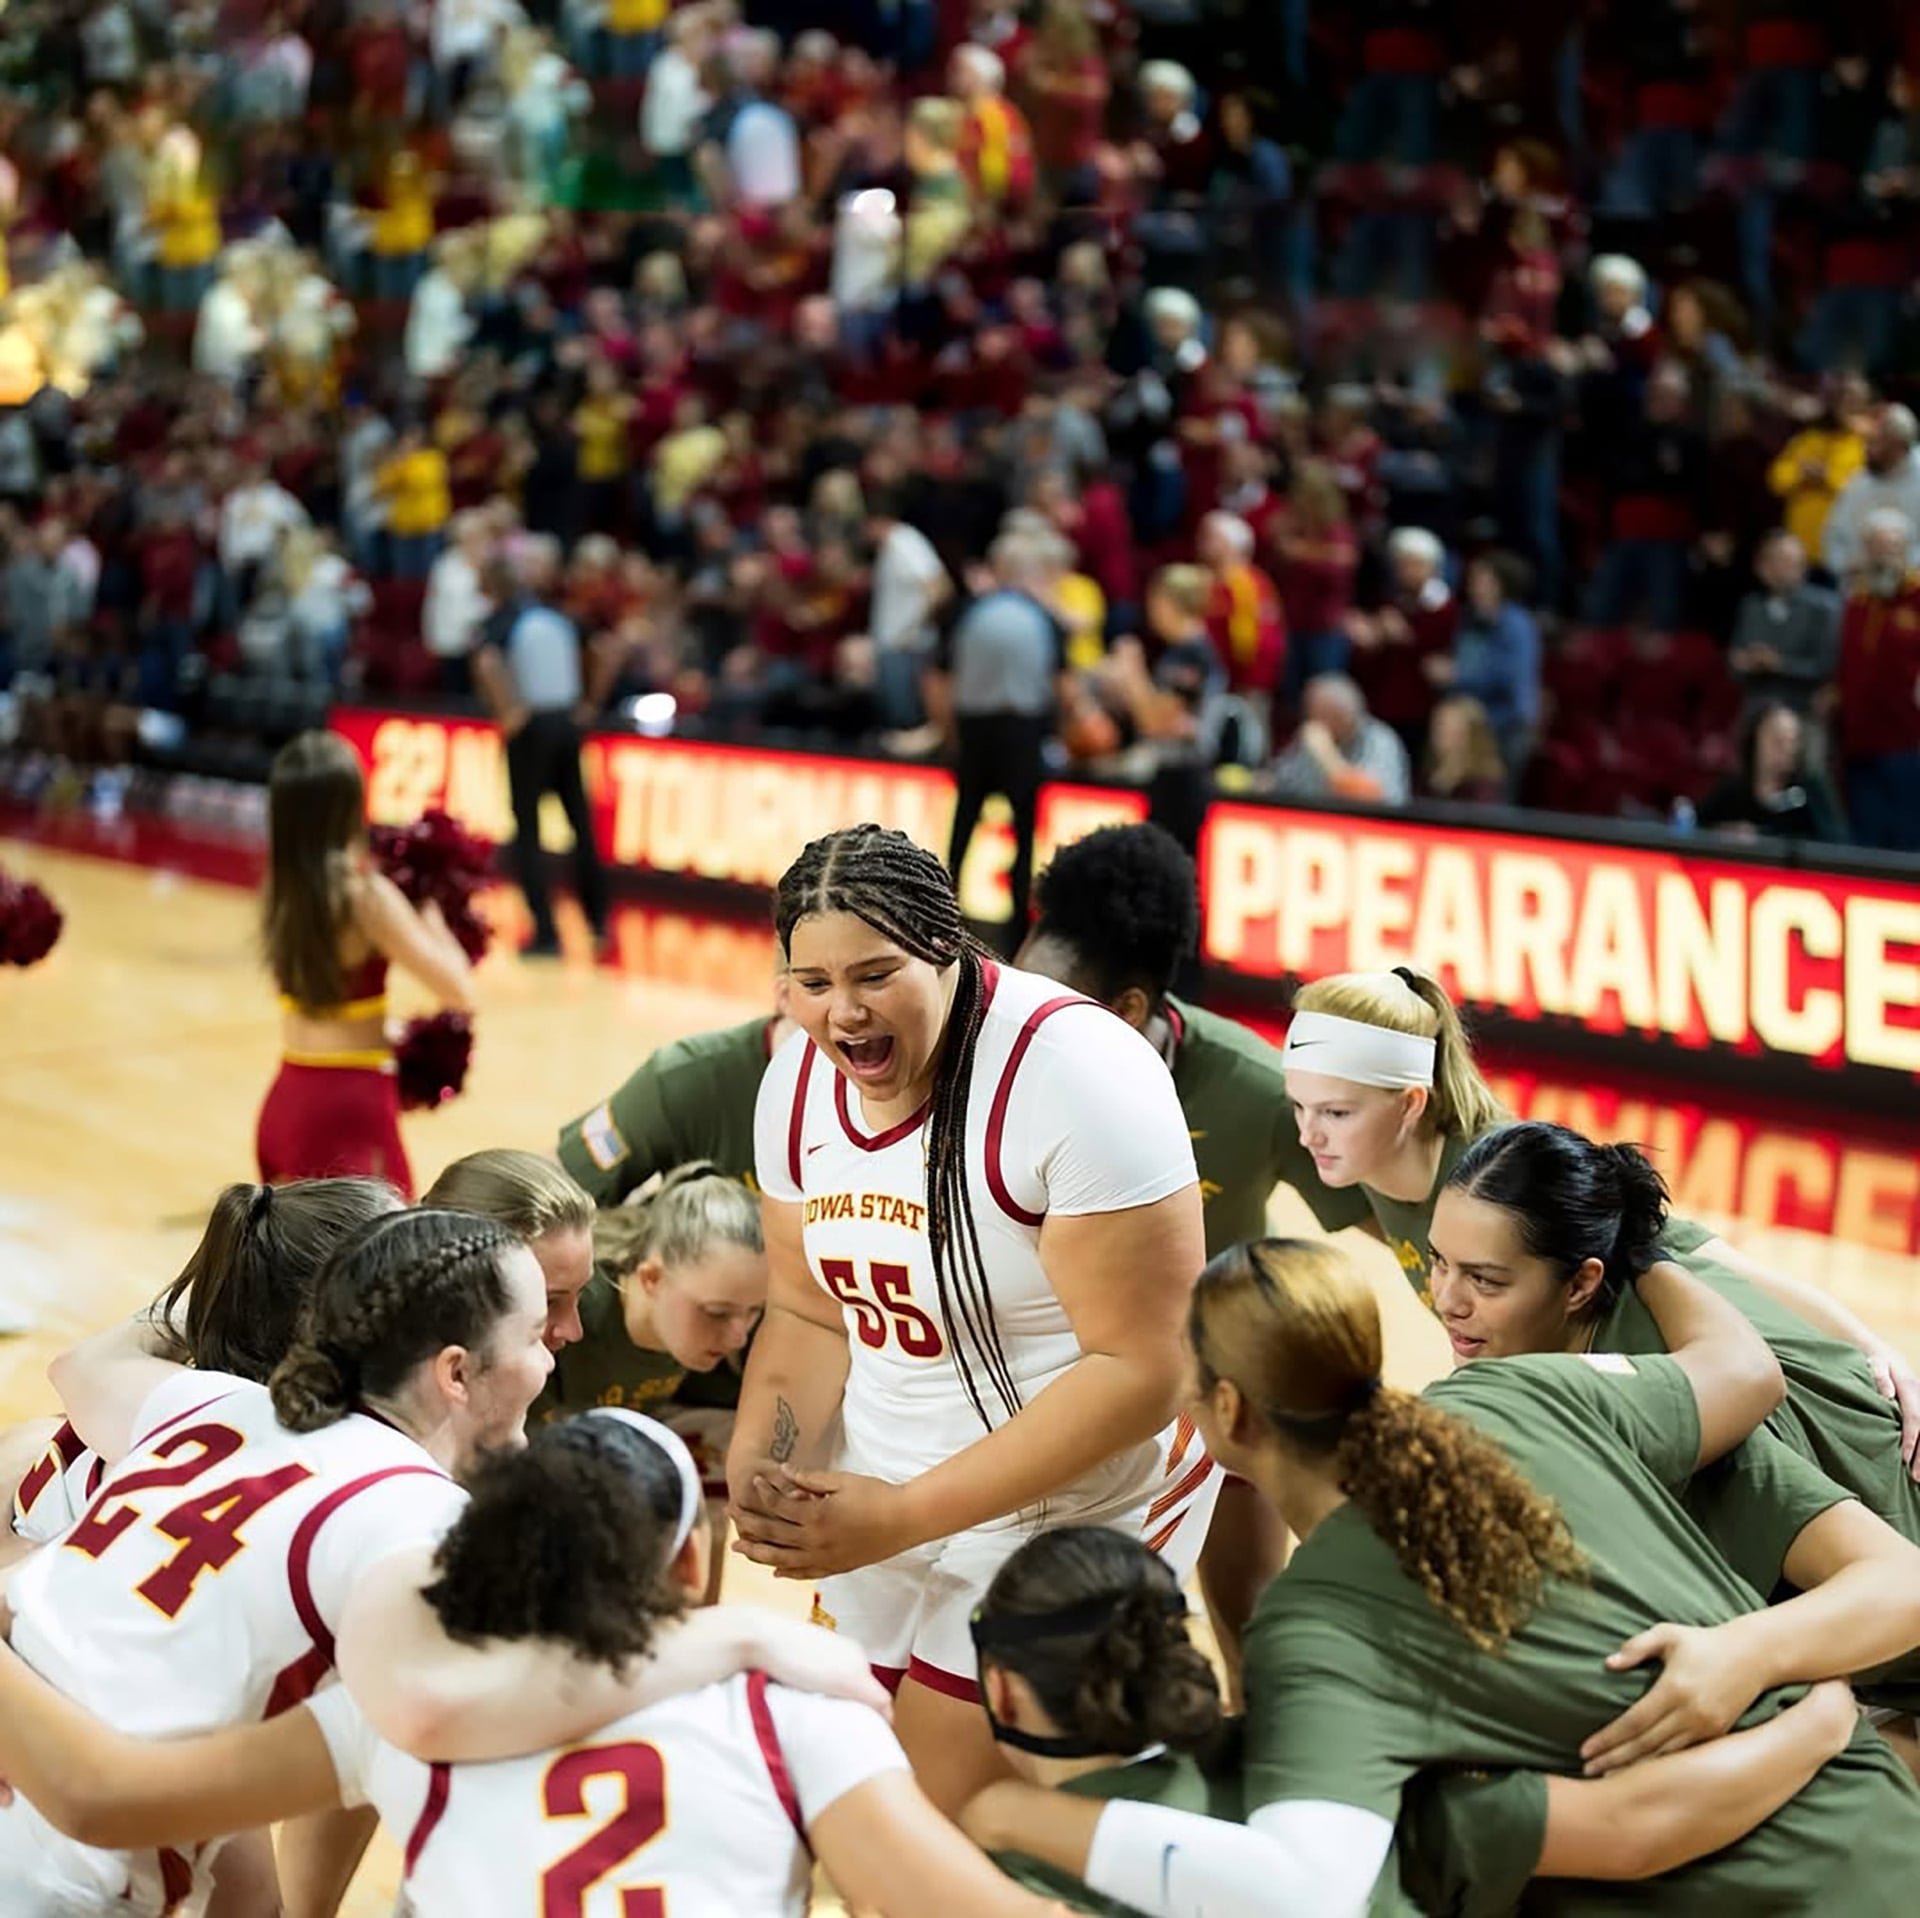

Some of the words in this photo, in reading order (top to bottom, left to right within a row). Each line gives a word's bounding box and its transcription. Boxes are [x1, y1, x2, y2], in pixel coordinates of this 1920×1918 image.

[1204, 815, 1920, 1072] PPEARANCE
[860, 1194, 925, 1231] STAT
[817, 1256, 945, 1359] 55
[63, 1421, 318, 1622] 24
[537, 1738, 669, 1918] 2
